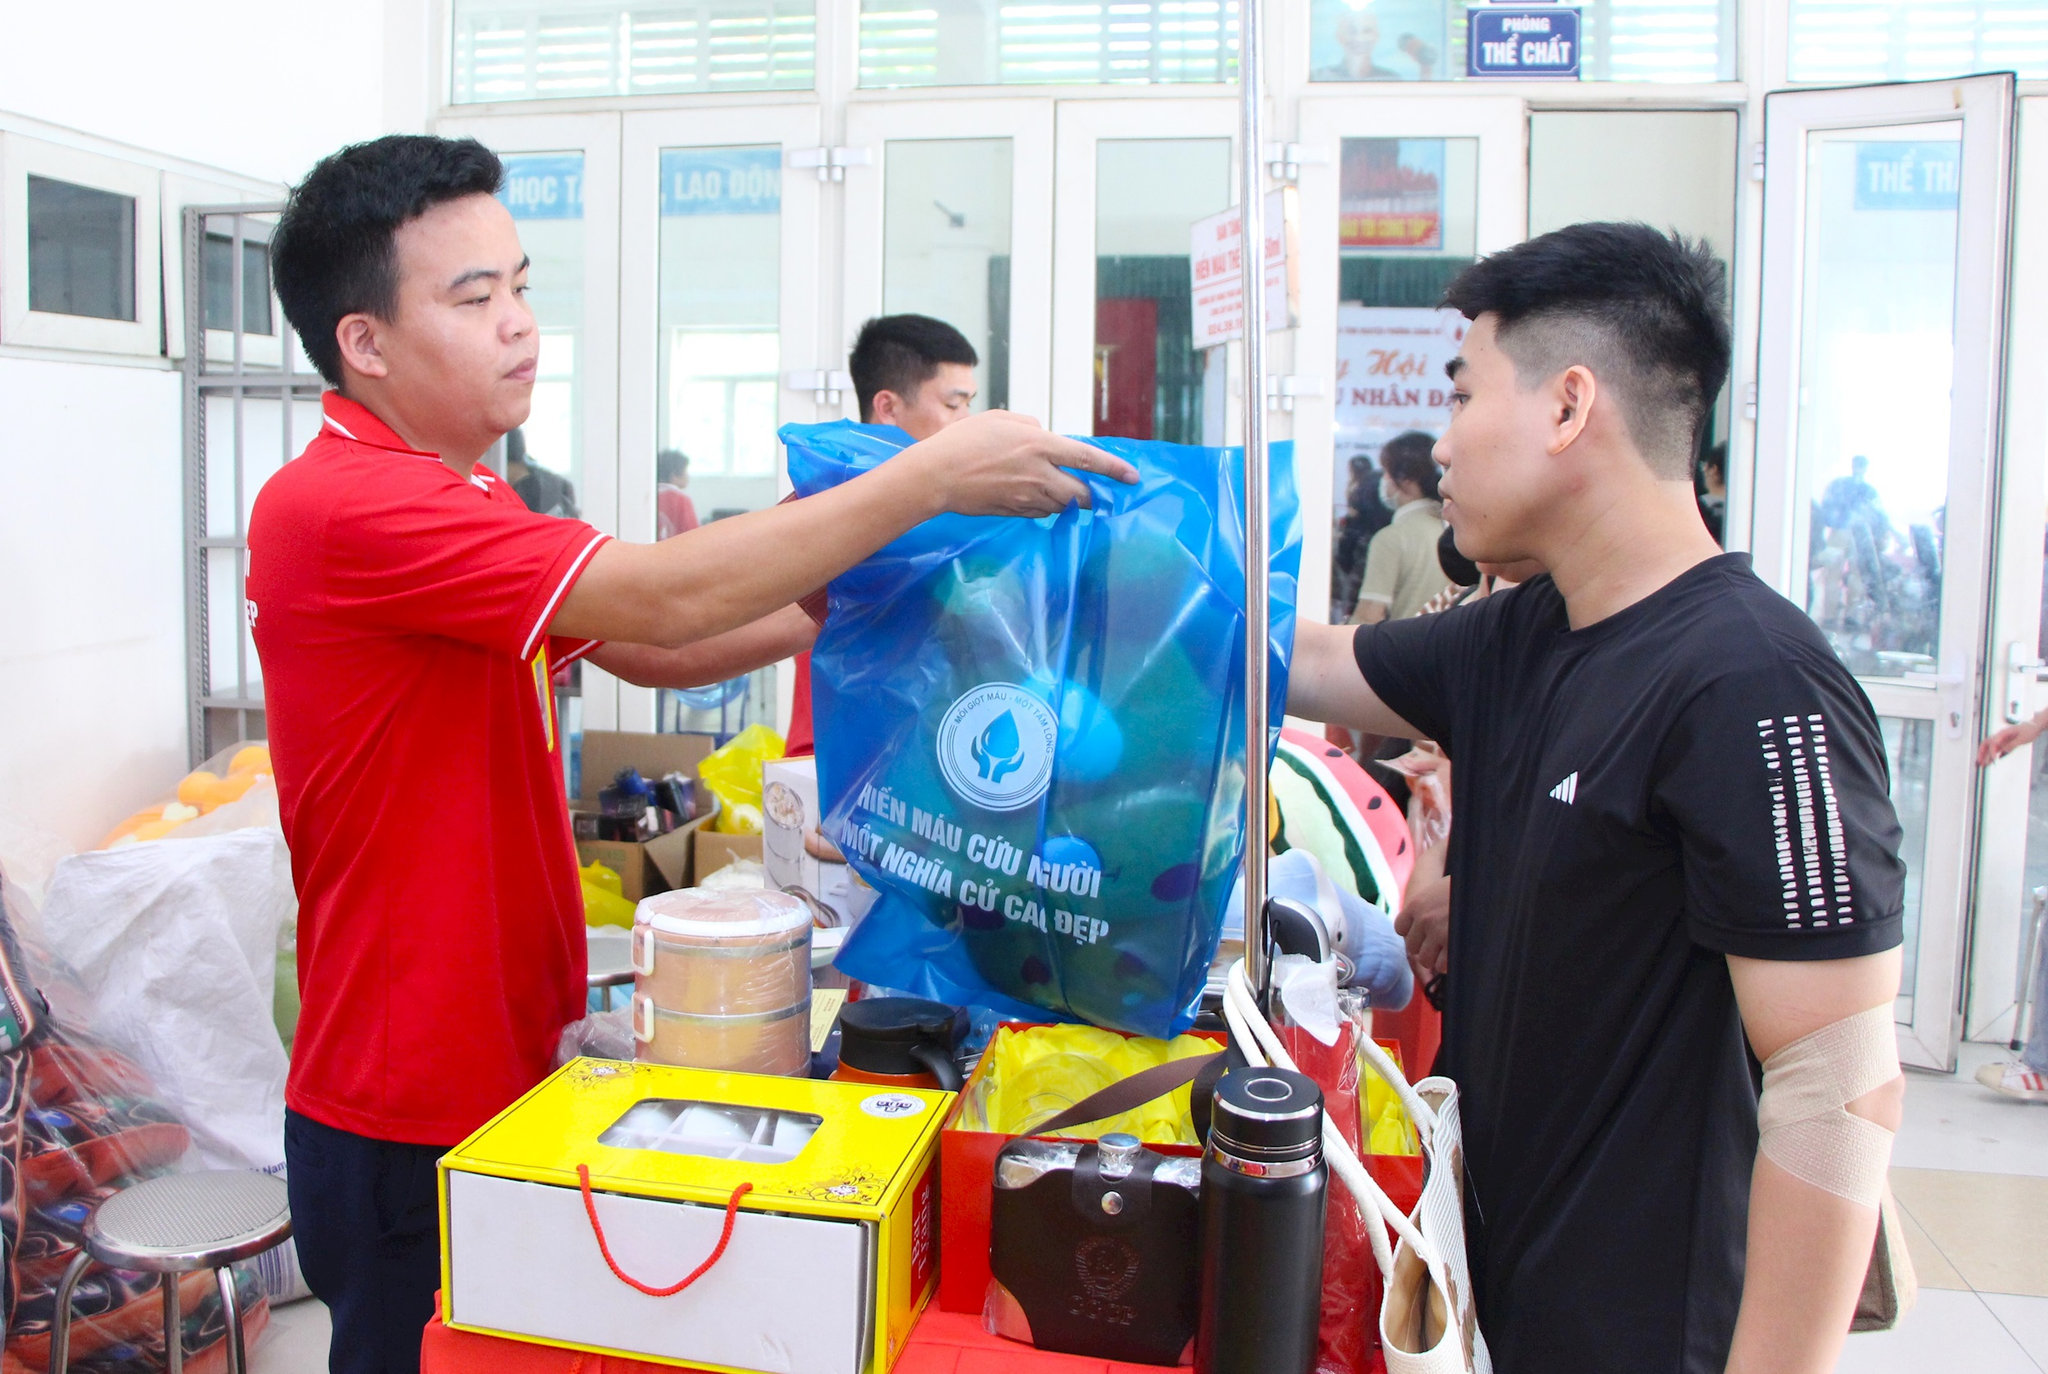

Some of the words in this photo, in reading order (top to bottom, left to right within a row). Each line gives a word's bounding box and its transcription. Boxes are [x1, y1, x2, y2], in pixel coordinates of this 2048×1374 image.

[1502, 14, 1551, 33] PHÒNG
[1482, 32, 1519, 65] THỂ
[1522, 33, 1572, 65] CHẤT
[1868, 147, 1916, 193] THỂ
[509, 175, 558, 214] HỌC
[674, 171, 721, 201] LAO
[1367, 347, 1428, 382] Hội
[1351, 382, 1419, 407] NHÂN
[987, 691, 1007, 702] MÁU
[911, 806, 963, 853] MÁU
[966, 835, 1023, 877] CỨU
[841, 818, 884, 861] MỘT
[880, 842, 953, 899] NGHĨA
[959, 878, 1001, 912] CỬ
[1054, 908, 1109, 946] ĐẸP
